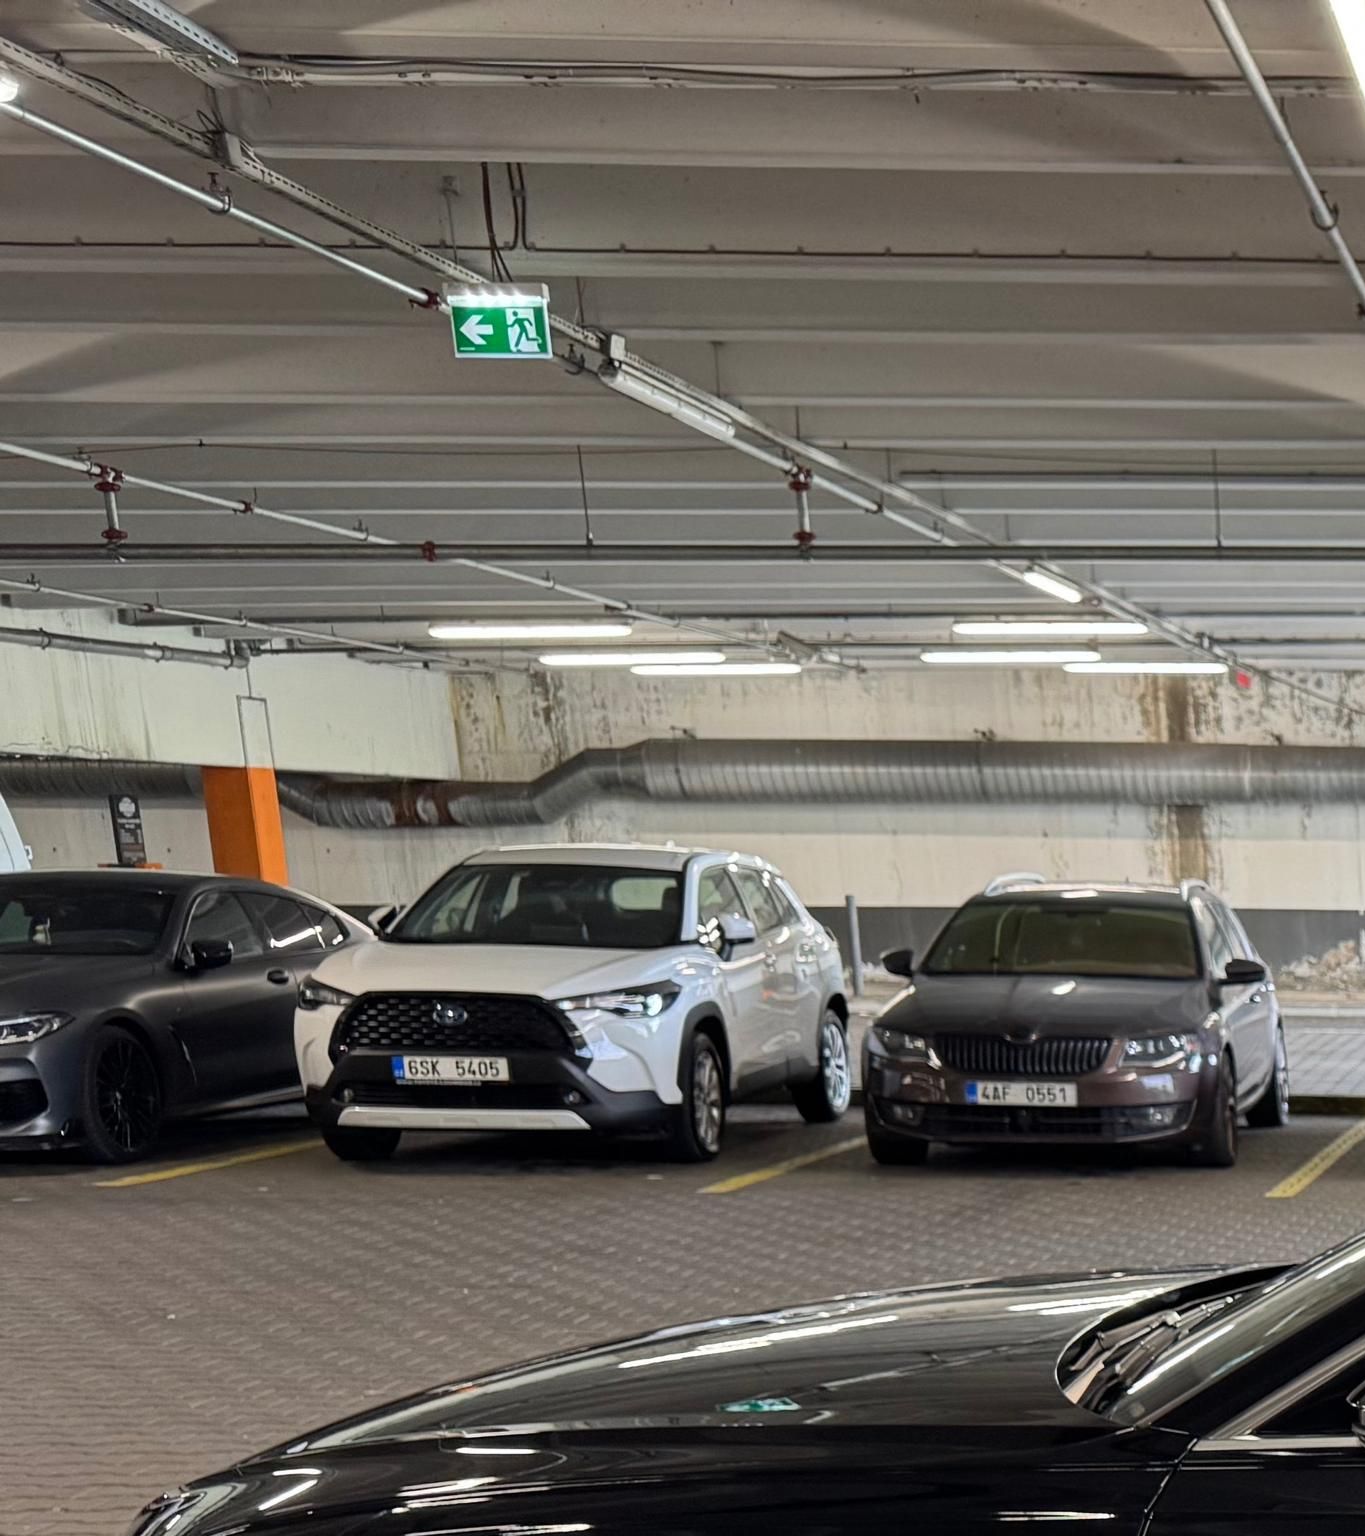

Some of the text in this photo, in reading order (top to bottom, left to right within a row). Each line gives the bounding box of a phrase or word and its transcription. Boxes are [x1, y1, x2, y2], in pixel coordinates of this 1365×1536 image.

[408, 1060, 500, 1077] 6SK 5405
[981, 1086, 1067, 1103] 4AF 0551
